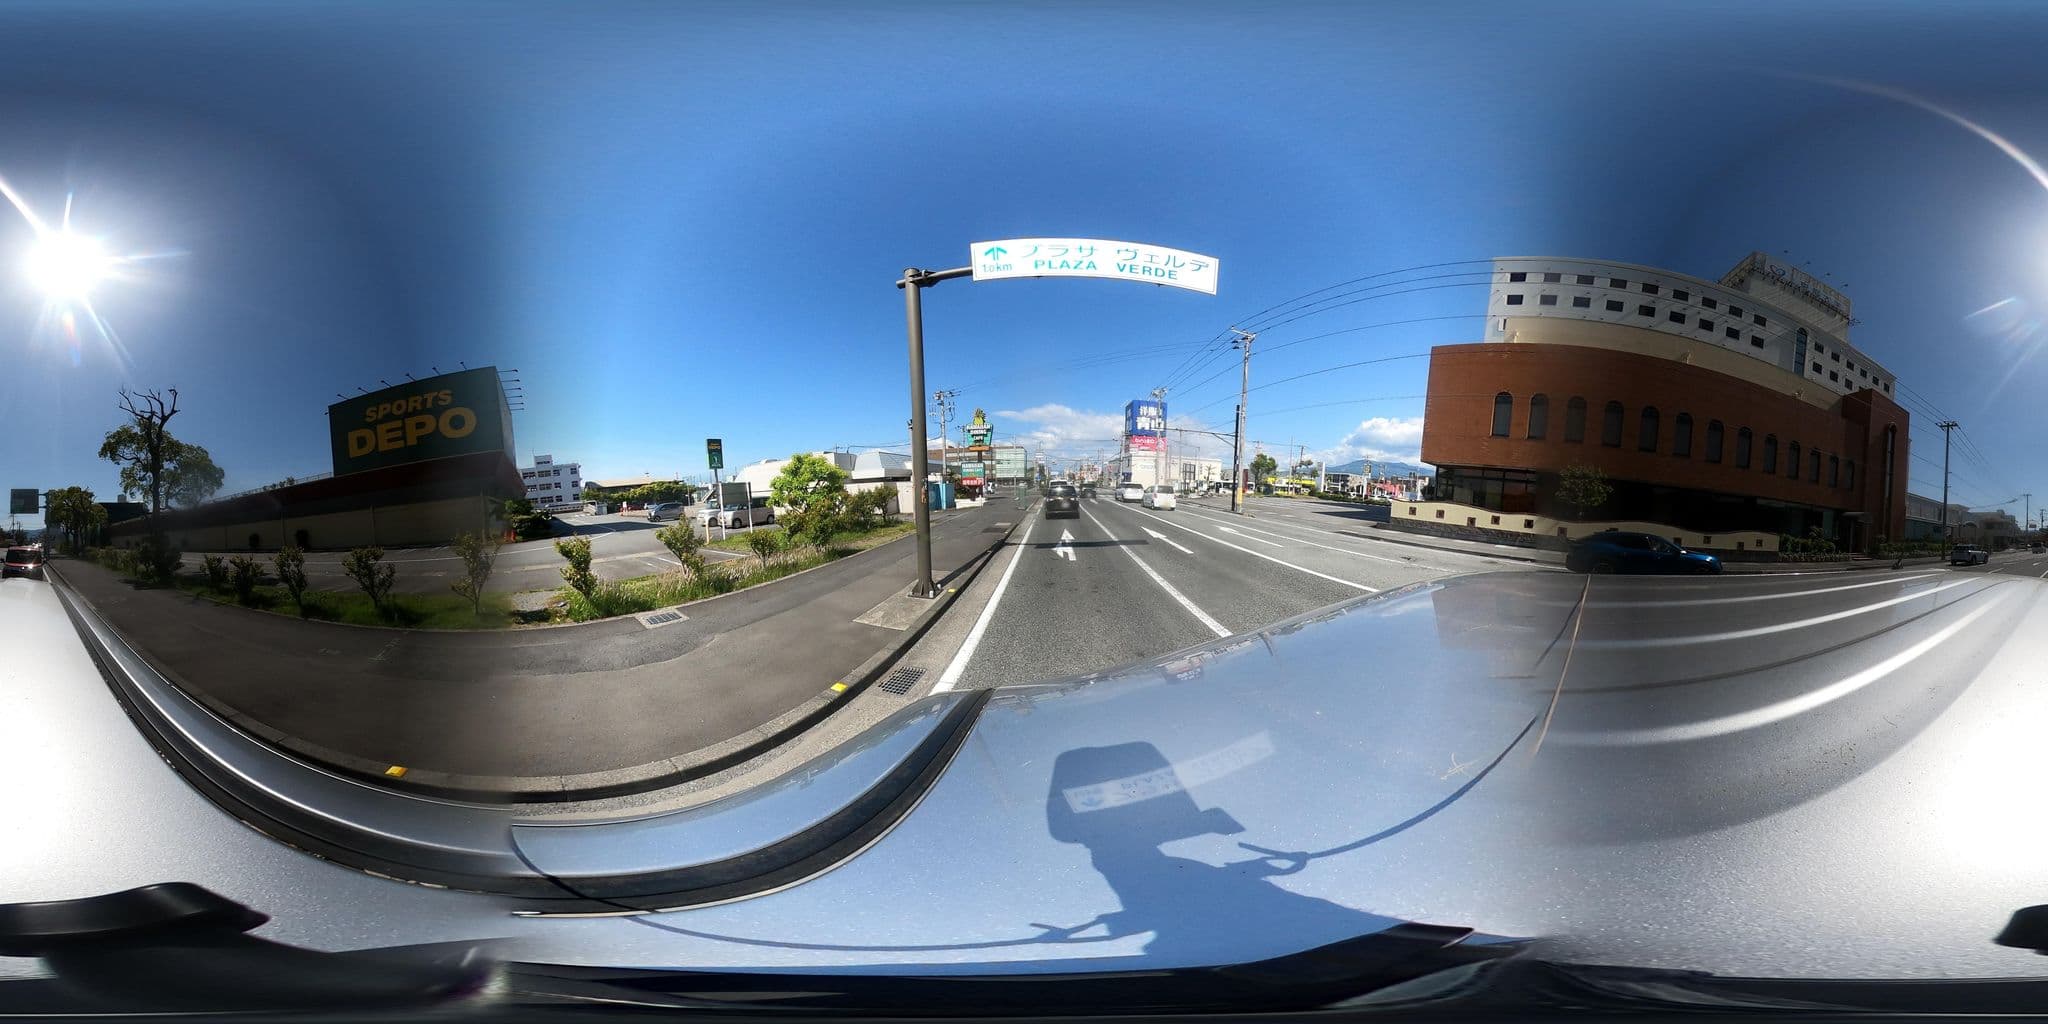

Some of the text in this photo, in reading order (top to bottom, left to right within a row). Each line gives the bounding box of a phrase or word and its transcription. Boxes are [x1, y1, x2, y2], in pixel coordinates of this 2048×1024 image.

[1034, 259, 1178, 280] PLAZA VERDE
[1116, 248, 1210, 272] ヴェルデ
[365, 390, 453, 422] SPORTS
[348, 407, 477, 458] DEPO
